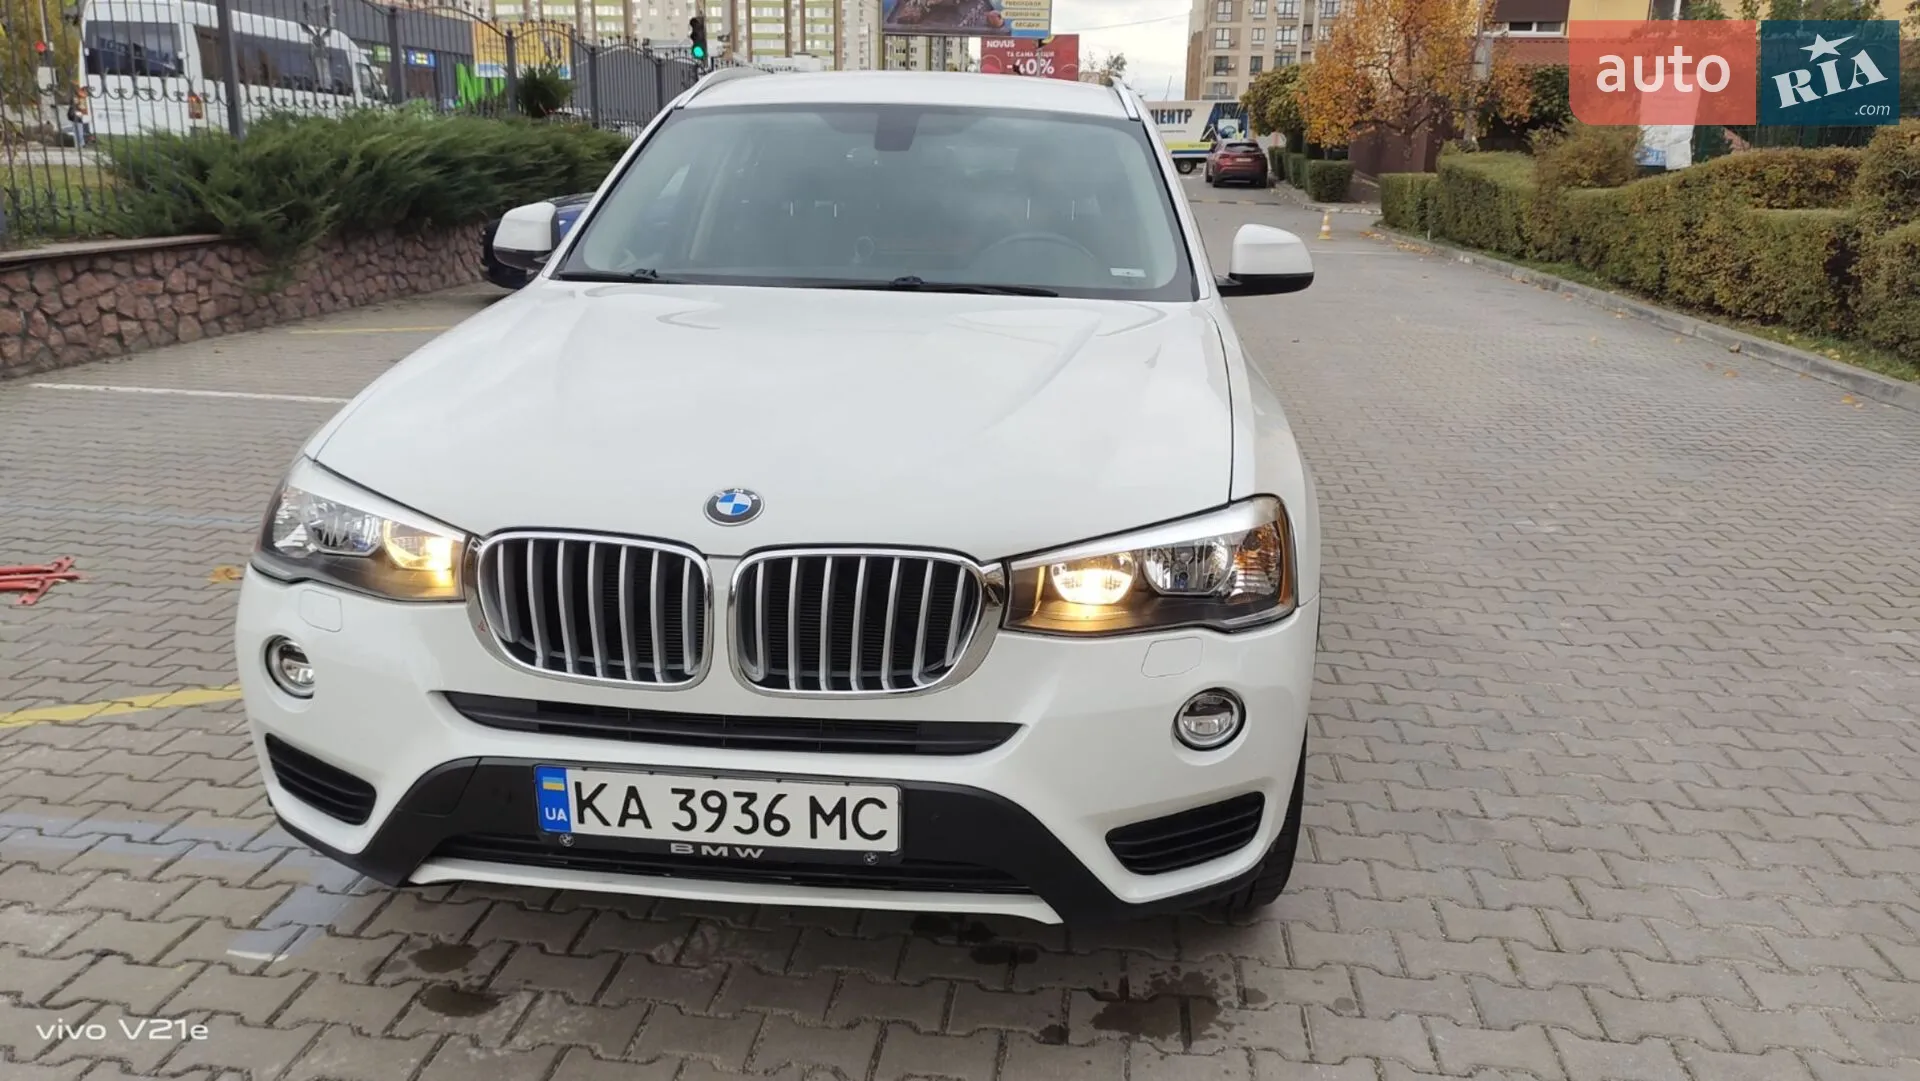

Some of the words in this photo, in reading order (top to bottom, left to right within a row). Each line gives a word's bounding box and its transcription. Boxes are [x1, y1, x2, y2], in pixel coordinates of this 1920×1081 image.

[987, 40, 1015, 48] NOVUS
[545, 806, 568, 822] UA
[574, 781, 653, 829] KA
[670, 787, 791, 837] 3936
[809, 795, 888, 841] MC
[670, 843, 764, 859] BMW
